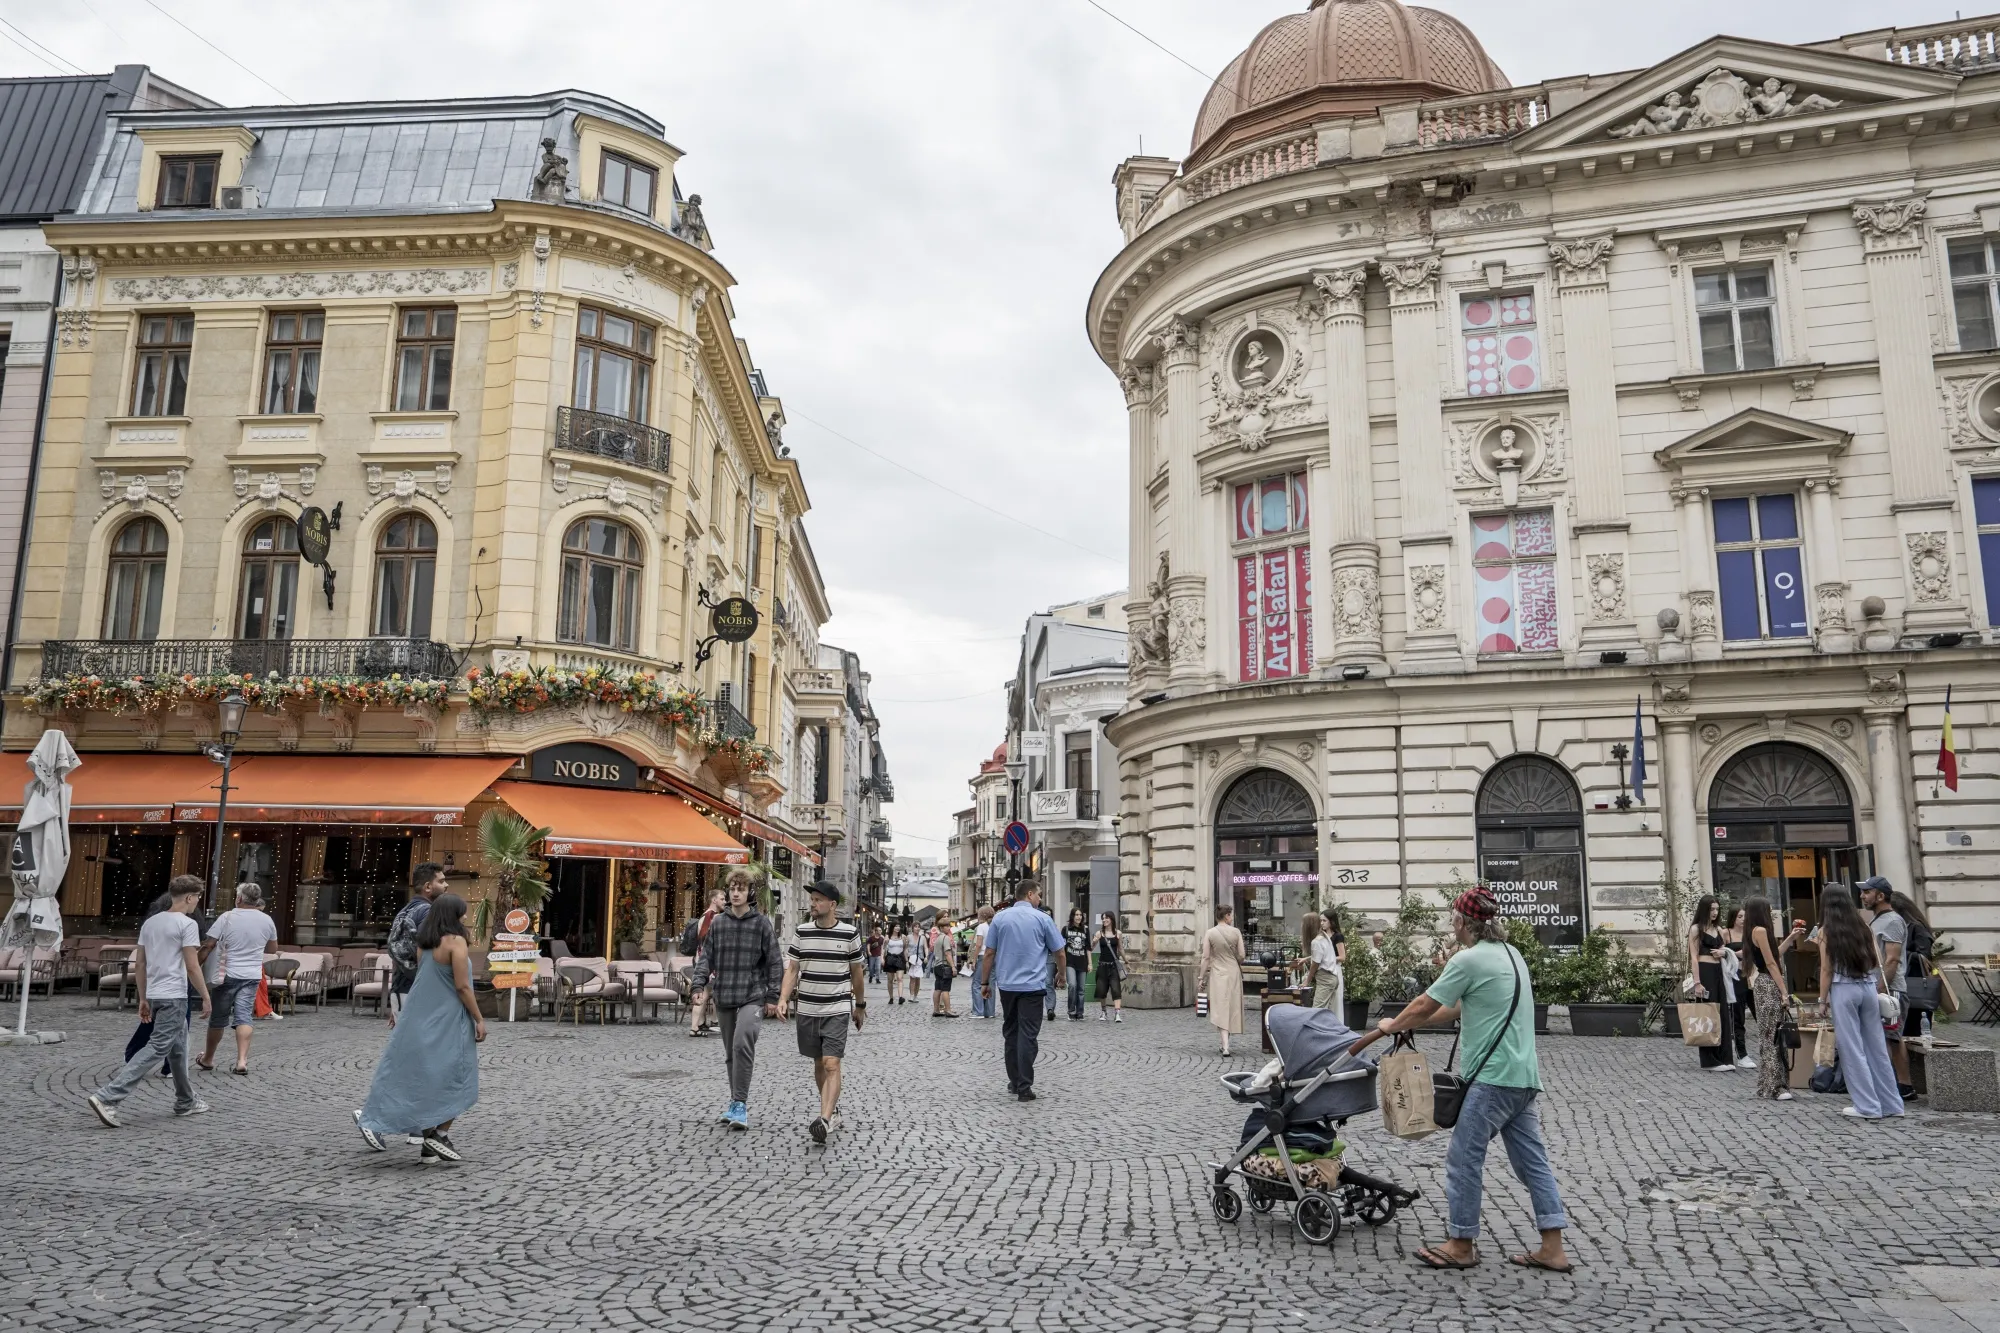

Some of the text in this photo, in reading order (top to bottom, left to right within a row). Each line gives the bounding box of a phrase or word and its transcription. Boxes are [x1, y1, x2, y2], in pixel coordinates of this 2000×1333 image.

[305, 526, 328, 546] NOBIS
[1244, 559, 1256, 587] visit
[1264, 555, 1289, 672] Art Safari
[718, 615, 753, 625] NOBIS
[1246, 621, 1258, 677] vizitează
[554, 759, 620, 781] NOBIS
[143, 810, 166, 819] APEROL
[179, 808, 202, 817] APEROL
[302, 809, 337, 819] NOBIS
[434, 812, 457, 821] APEROL
[551, 843, 573, 852] APEROL
[638, 848, 670, 857] NOBIS
[1233, 876, 1246, 884] BOB
[1248, 875, 1275, 883] GEORGE
[1277, 874, 1303, 882] COFFEE
[1490, 881, 1558, 891] FROM OUR
[1497, 903, 1560, 914] HAMPION
[1551, 915, 1578, 925] CUP
